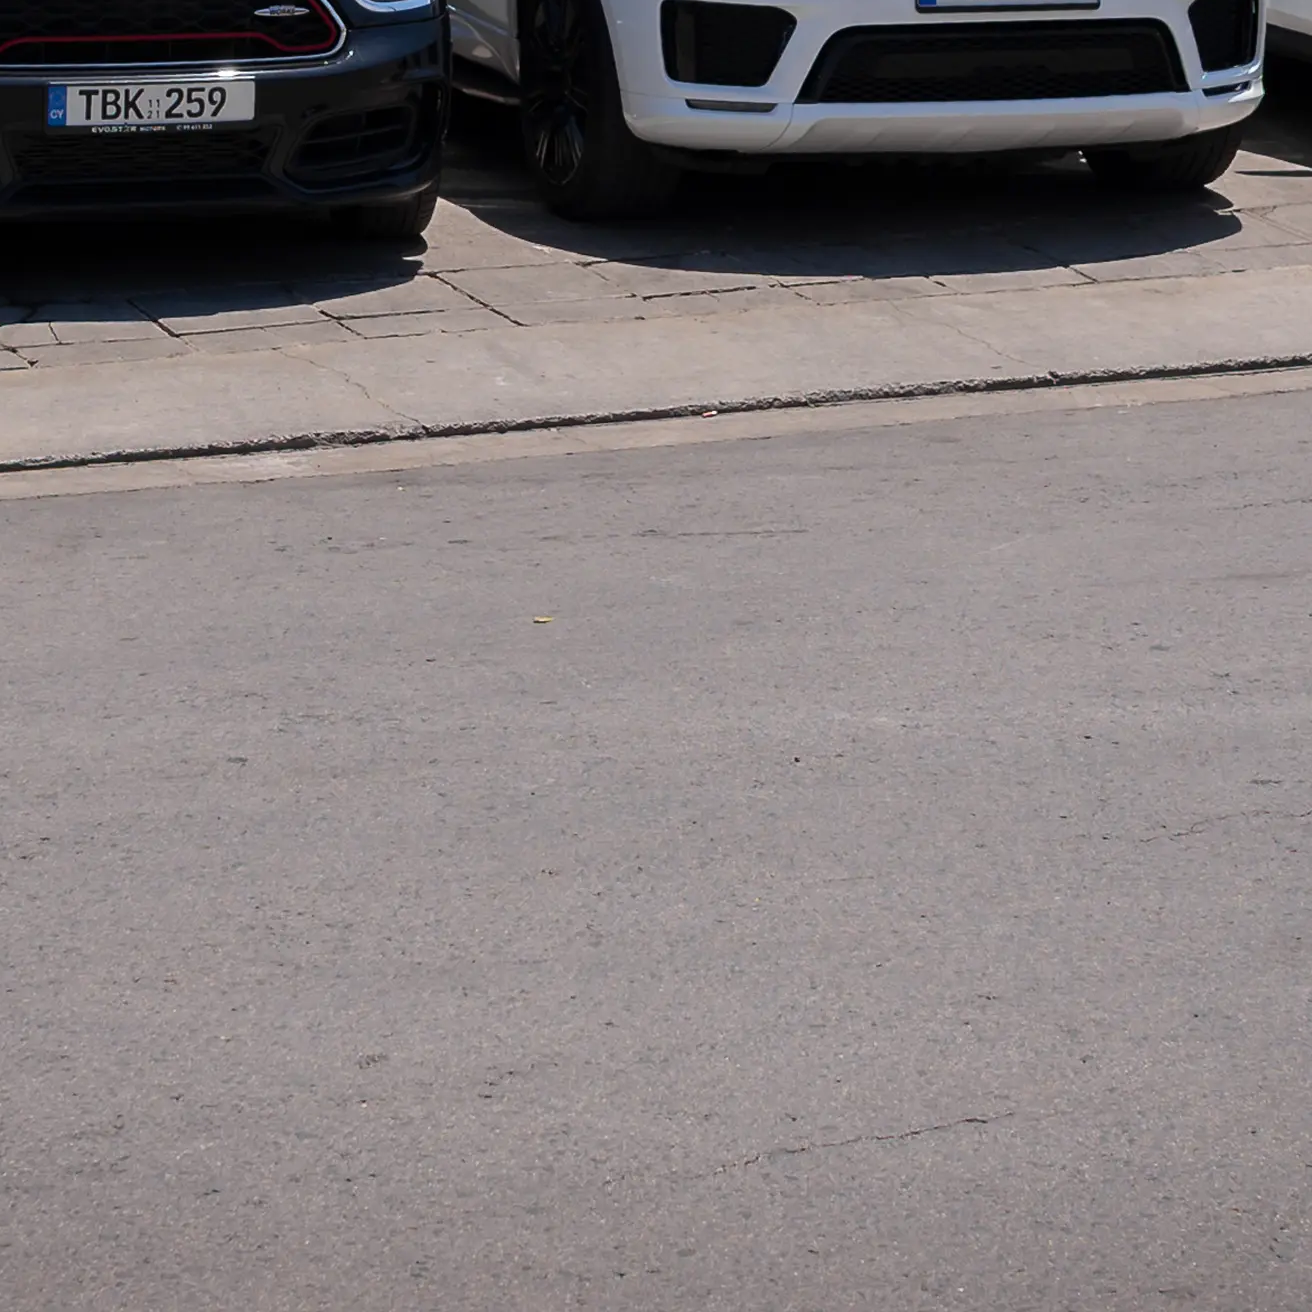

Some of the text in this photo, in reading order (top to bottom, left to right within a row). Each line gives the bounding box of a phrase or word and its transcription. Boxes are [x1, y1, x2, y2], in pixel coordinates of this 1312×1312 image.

[49, 108, 65, 120] CY
[78, 86, 228, 121] TBK 259
